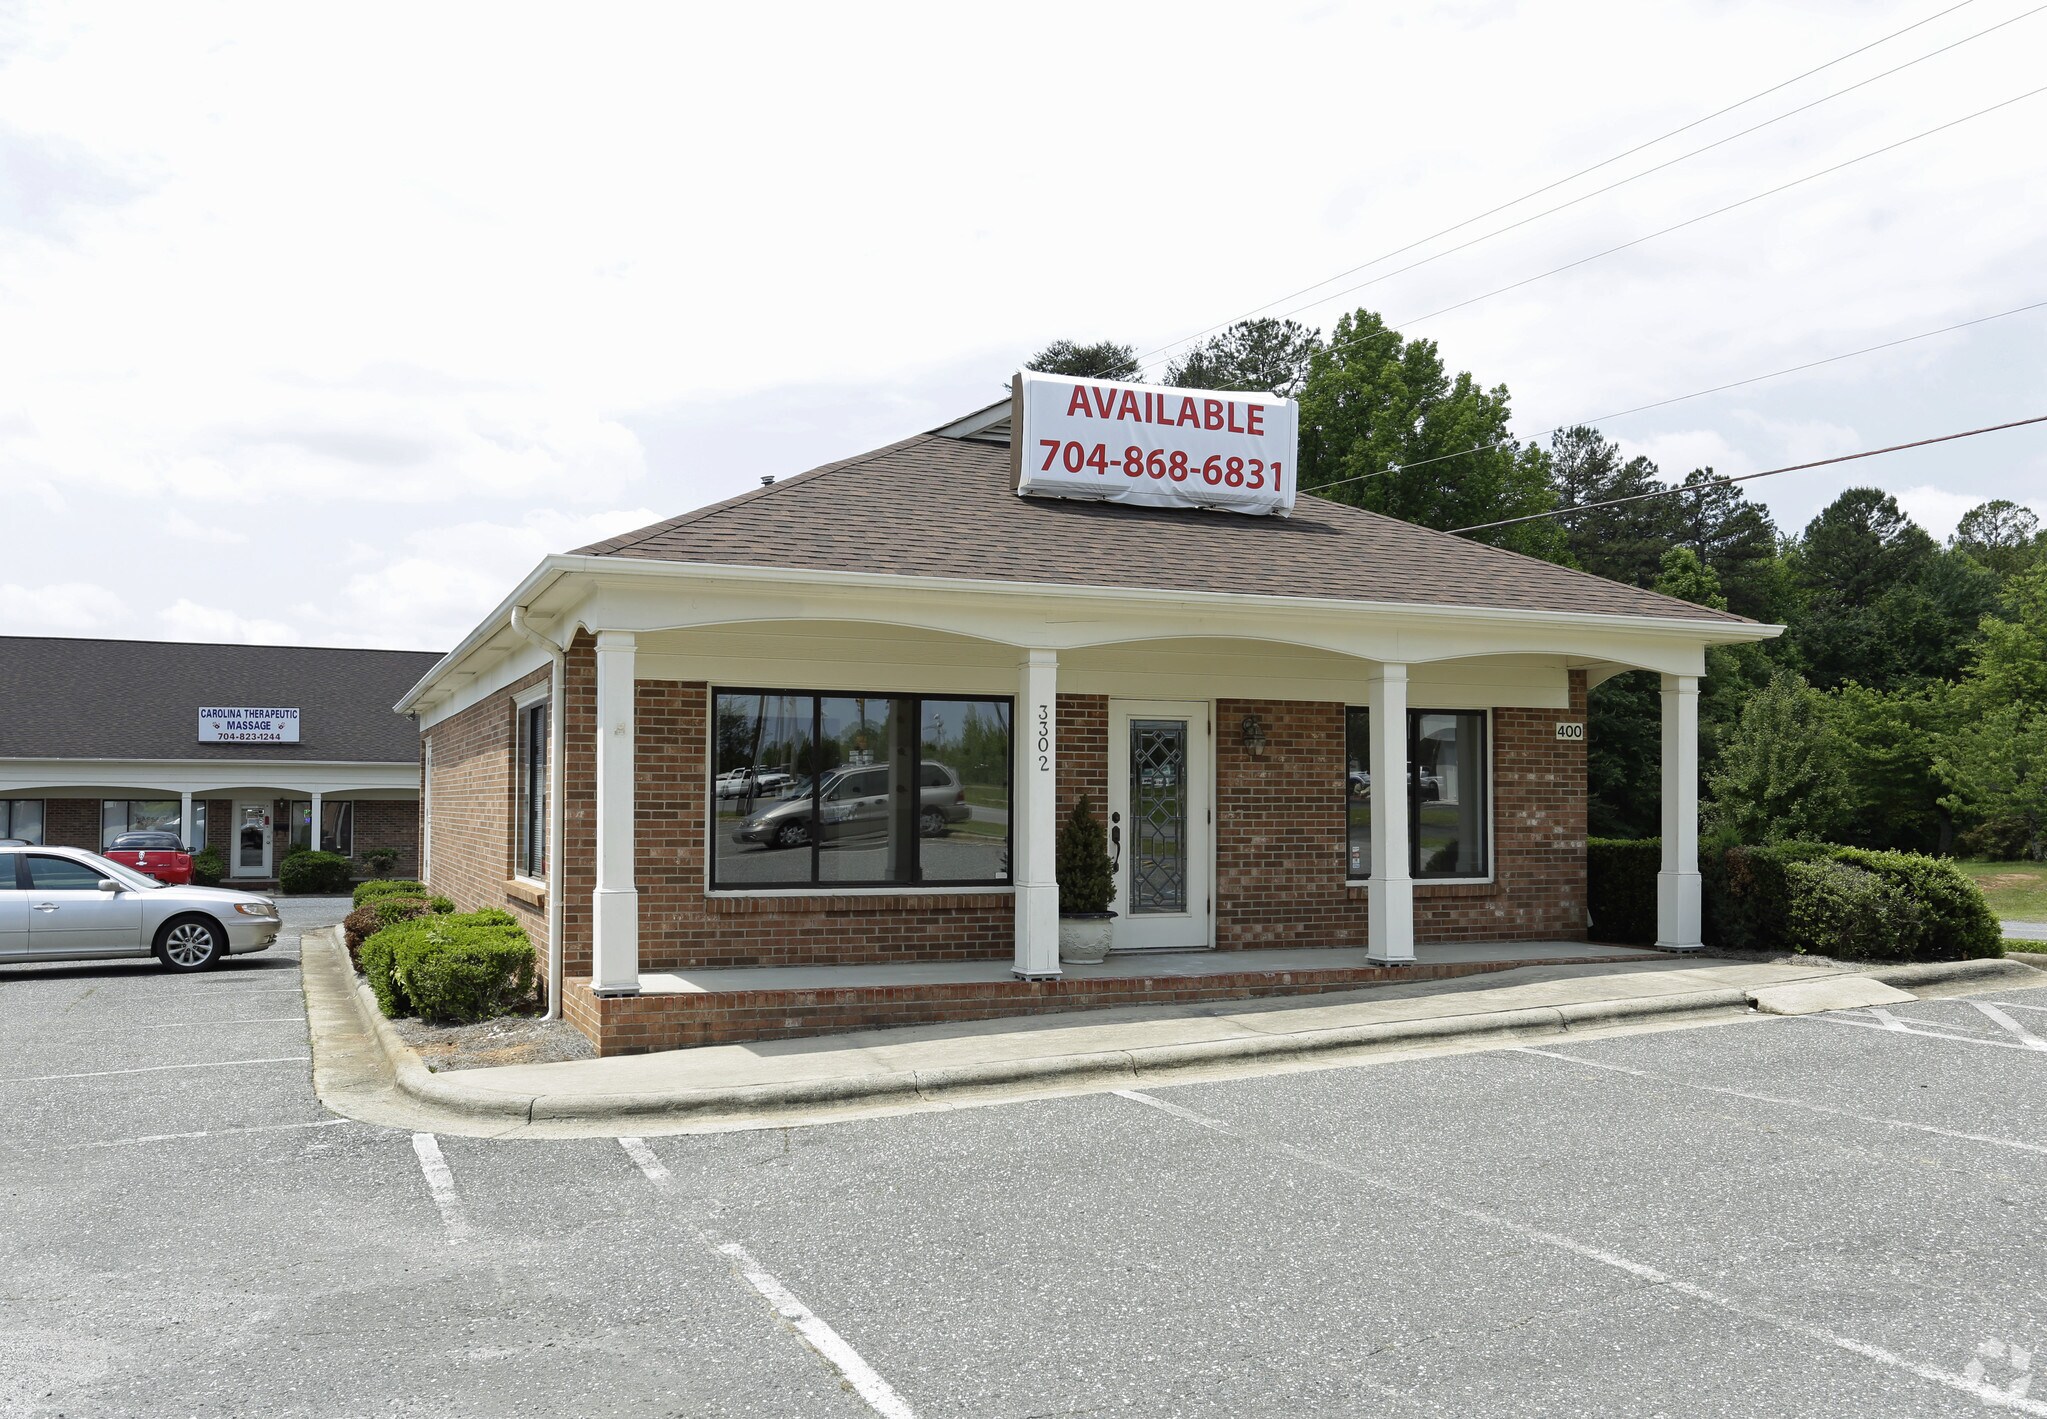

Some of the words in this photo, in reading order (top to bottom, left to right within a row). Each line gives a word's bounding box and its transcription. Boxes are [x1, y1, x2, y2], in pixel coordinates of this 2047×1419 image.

[1066, 385, 1264, 436] AVAILABLE
[1039, 439, 1282, 491] 704-868-6831
[200, 709, 241, 718] CAROLINA
[245, 709, 298, 719] THERAPEUTIC
[227, 721, 271, 730] MASSAGE
[1038, 705, 1049, 771] 3302
[1558, 725, 1582, 738] 400
